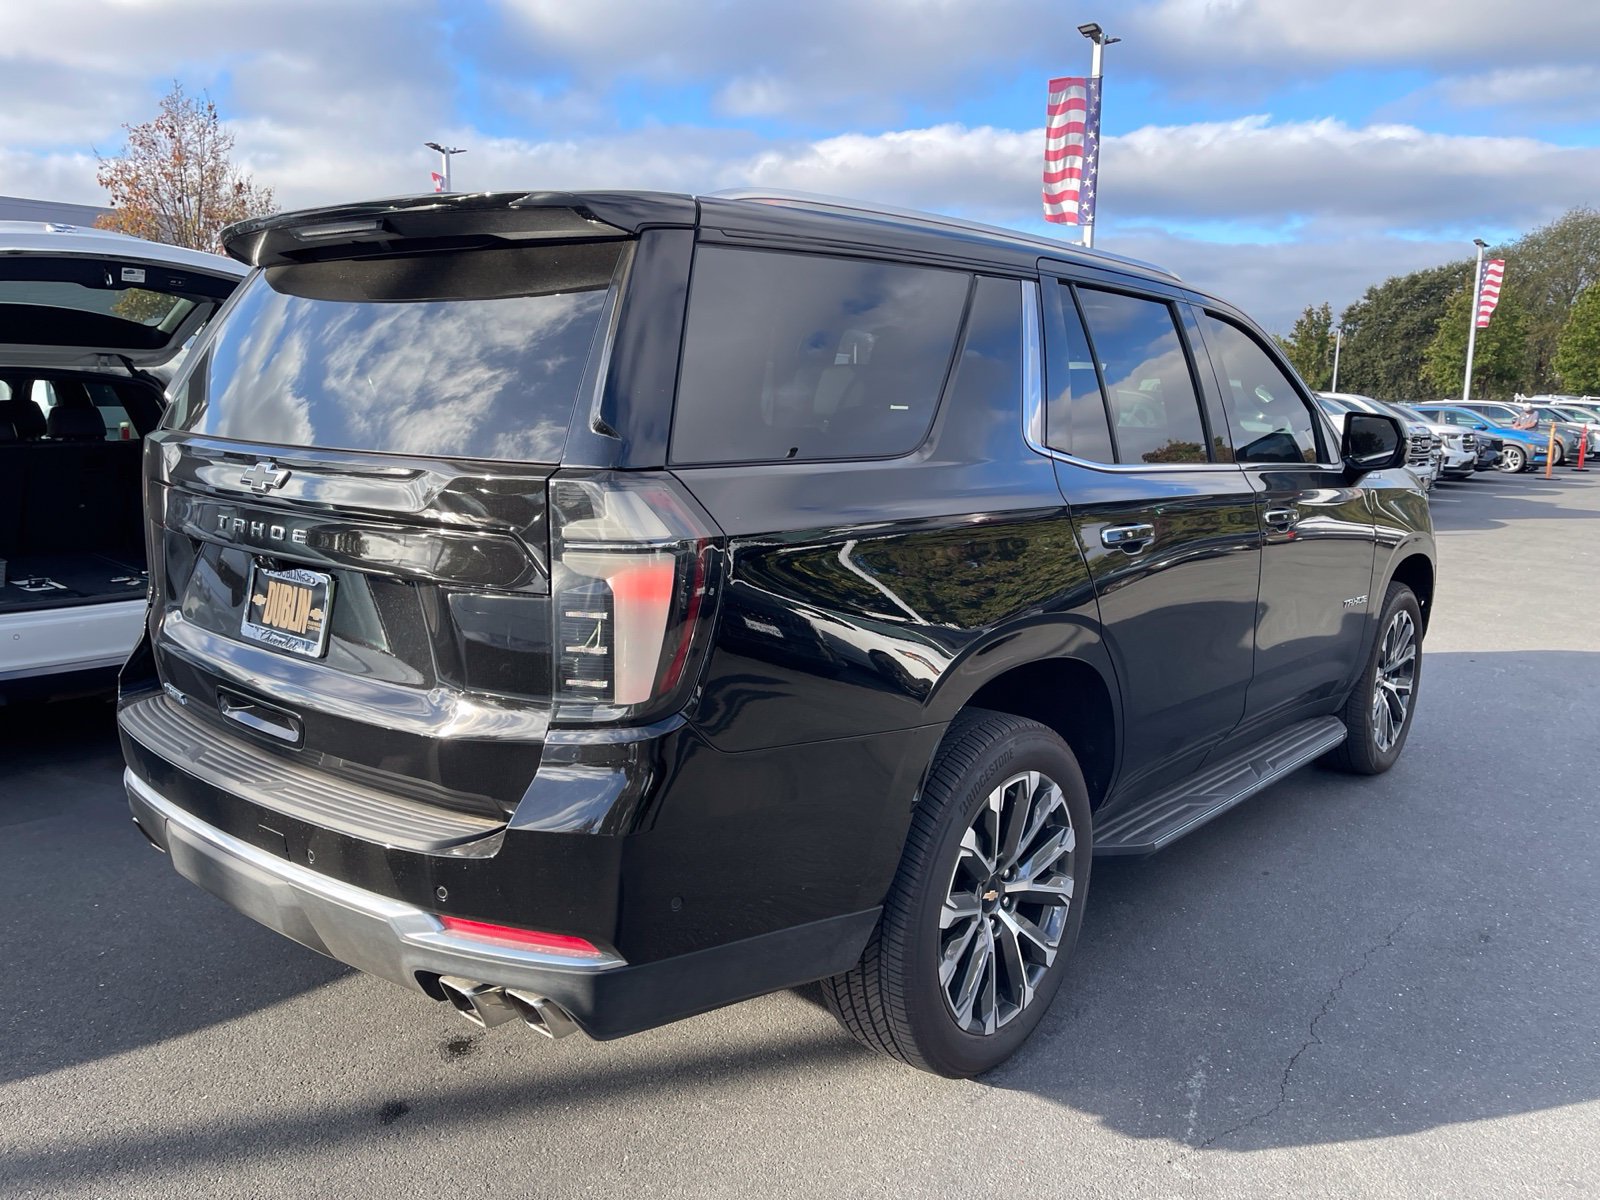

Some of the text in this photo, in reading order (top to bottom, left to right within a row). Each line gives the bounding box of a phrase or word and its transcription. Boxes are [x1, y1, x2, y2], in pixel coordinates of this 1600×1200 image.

[217, 514, 308, 544] TAHOE
[262, 580, 312, 634] DUBLIN
[1343, 594, 1367, 608] TAHOE
[959, 747, 1015, 817] BRIDGESTONE
